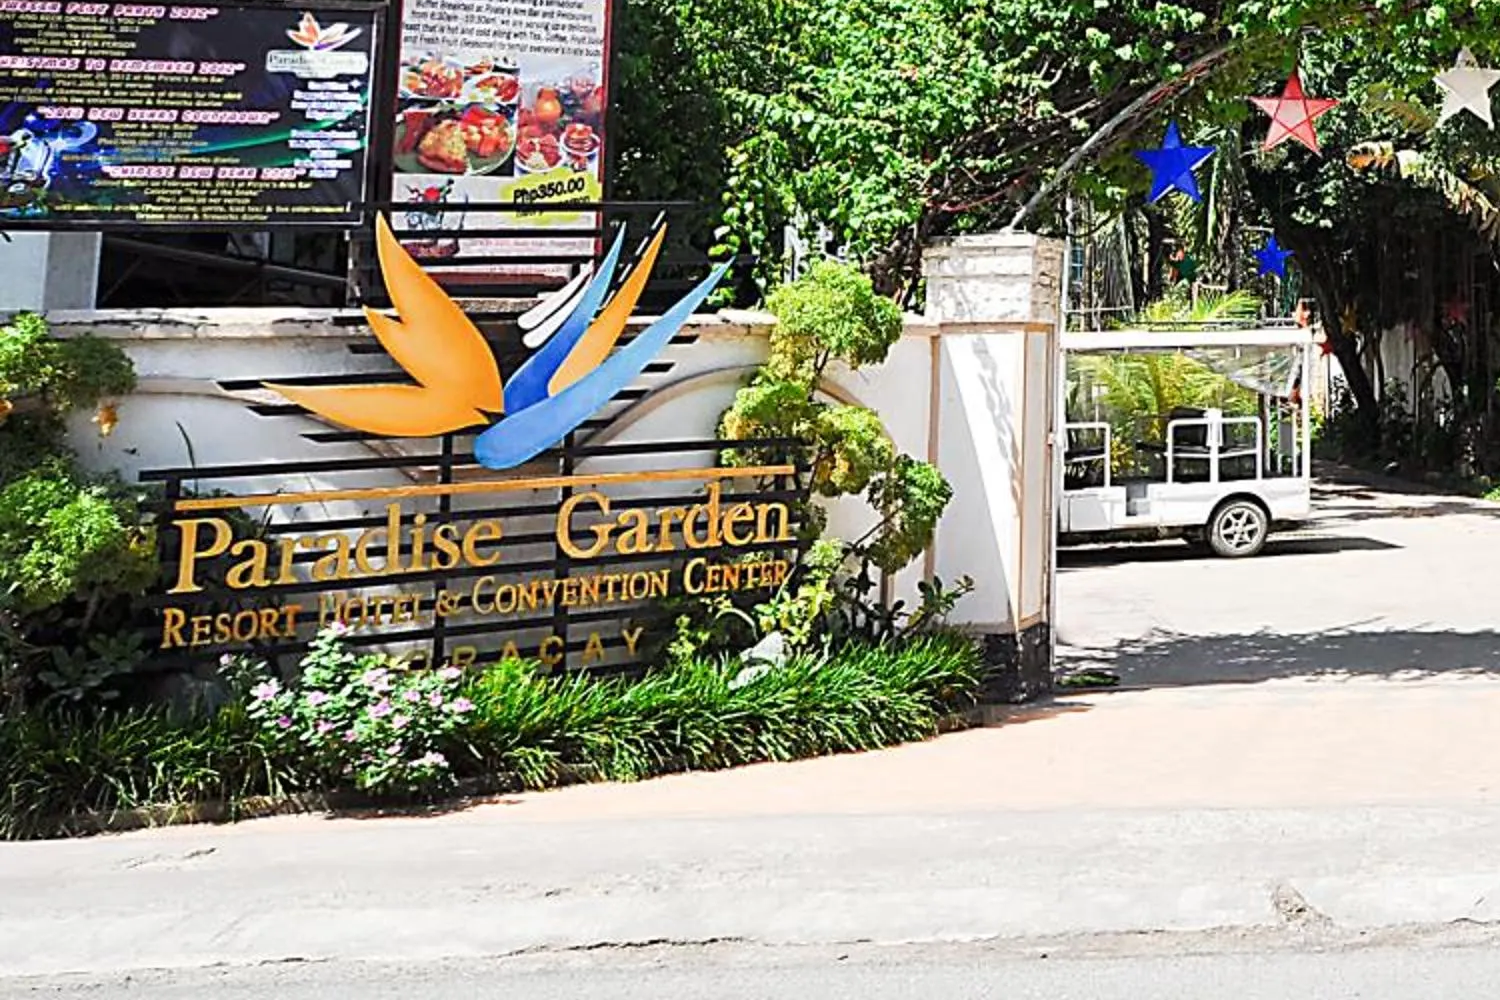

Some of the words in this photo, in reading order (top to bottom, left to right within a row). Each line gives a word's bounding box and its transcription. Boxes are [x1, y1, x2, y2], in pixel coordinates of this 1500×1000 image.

[514, 177, 585, 206] Php350.00
[166, 503, 503, 595] Paradise
[556, 482, 797, 559] Garden
[160, 604, 302, 649] RESORT
[317, 589, 430, 628] HOTEL
[435, 588, 462, 617] &
[472, 568, 670, 615] CONVENTION
[683, 556, 789, 594] CENTER
[404, 627, 643, 674] ORACAY
